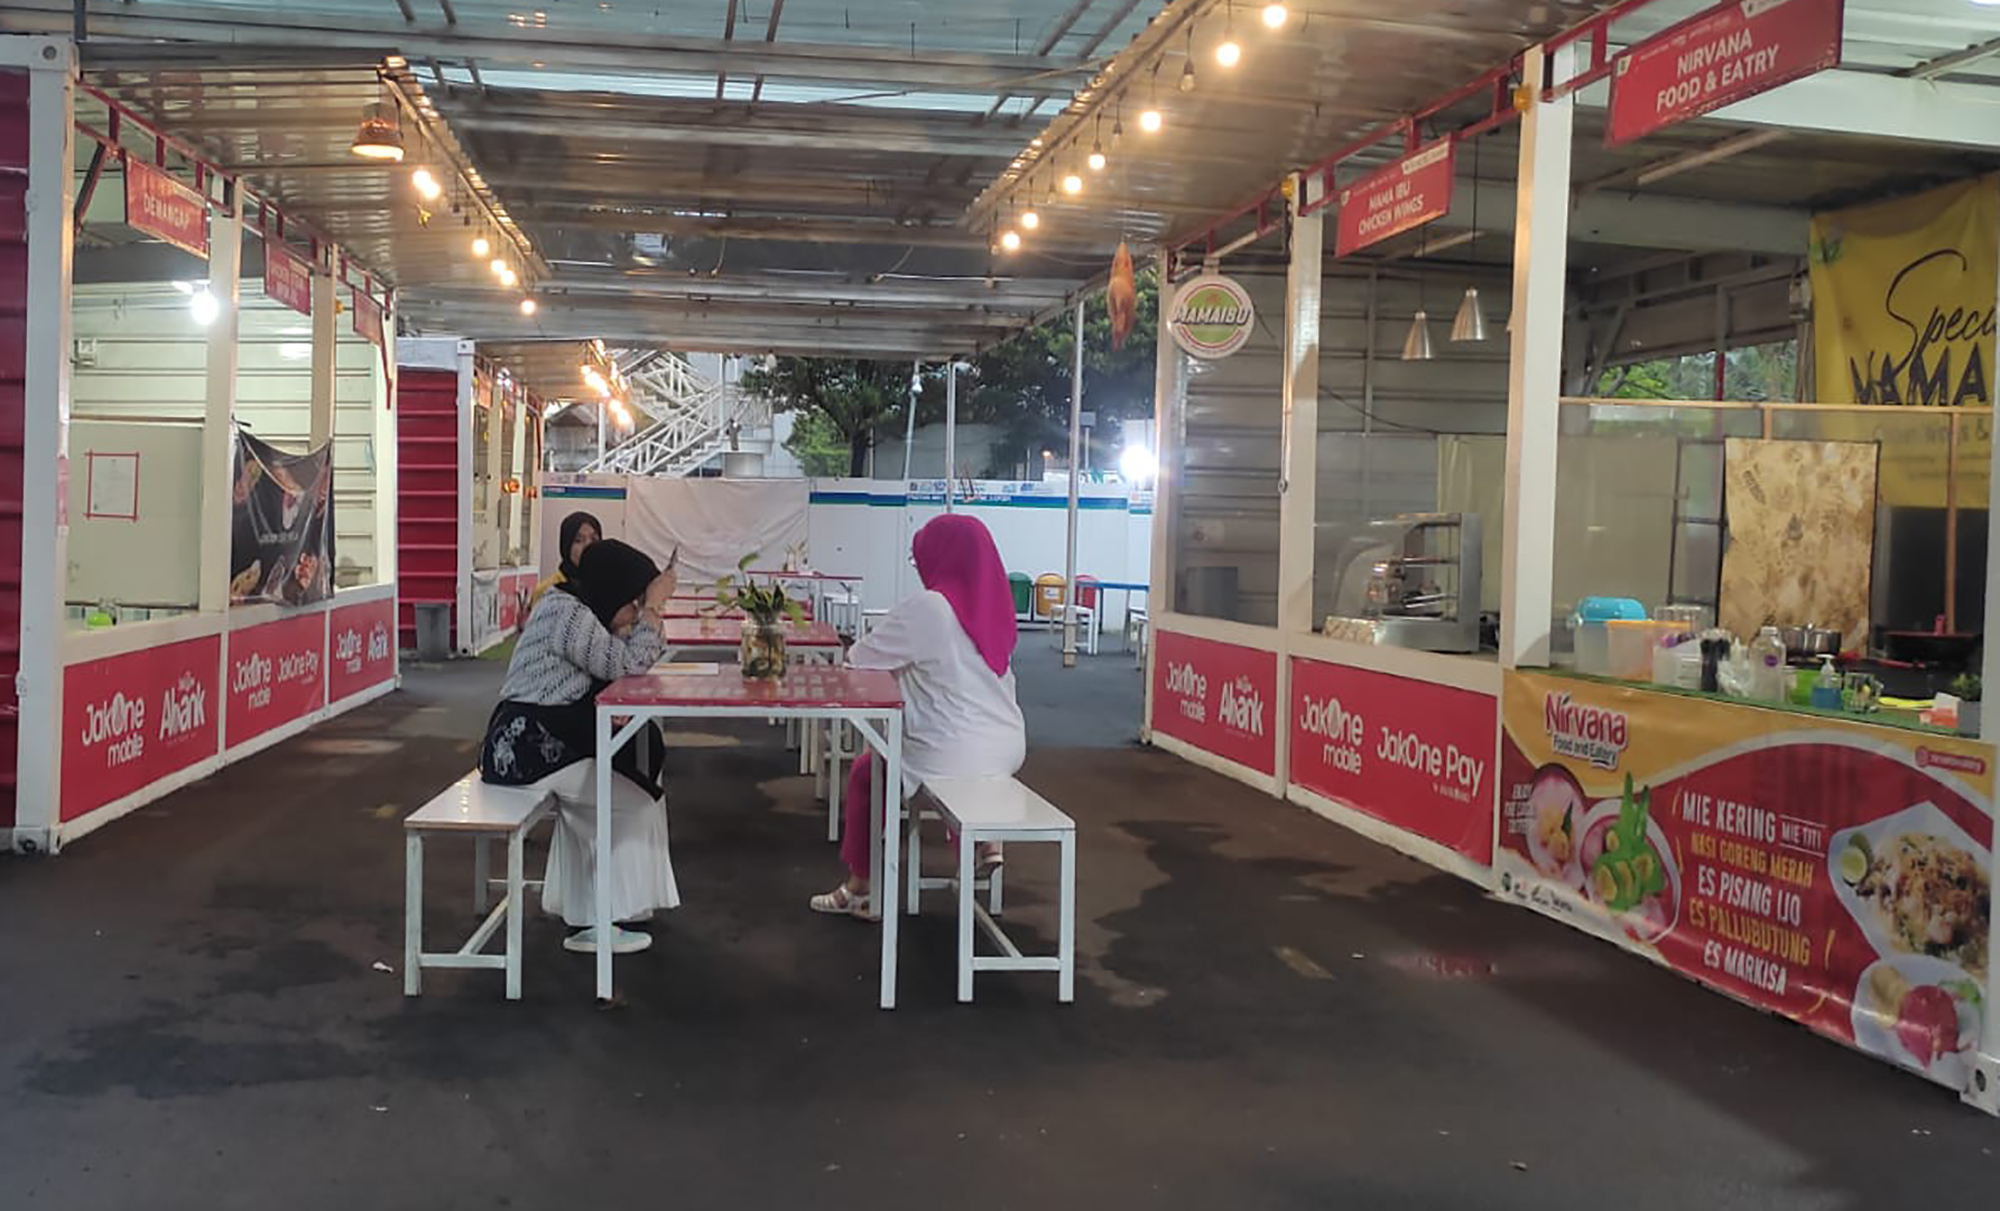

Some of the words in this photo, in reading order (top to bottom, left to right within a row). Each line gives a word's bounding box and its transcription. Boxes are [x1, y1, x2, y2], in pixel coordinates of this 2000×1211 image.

[1656, 77, 1701, 112] FOOD
[1705, 70, 1717, 93] &
[1721, 44, 1779, 87] EATRY
[1677, 28, 1752, 79] NIRVANA
[1358, 207, 1393, 235] CHICKEN
[1394, 193, 1424, 219] WINGS
[1174, 305, 1252, 327] MAMAIBU
[233, 652, 271, 693] JakOne
[277, 653, 304, 683] JakOne
[305, 650, 318, 676] Pay
[1165, 661, 1207, 700] JakOne
[82, 691, 145, 746] JakOne
[1180, 699, 1206, 724] mobile
[1300, 694, 1364, 747] JakOne
[1546, 691, 1627, 747] Nirvana
[107, 731, 144, 769] mobile
[1323, 743, 1362, 776] mobile
[1377, 726, 1443, 777] JakOne
[1446, 745, 1485, 798] Pay
[1553, 734, 1573, 752] Food
[1574, 737, 1590, 756] and
[1682, 791, 1712, 827] MIE
[1716, 798, 1777, 844] KERING
[1781, 821, 1800, 844] MIE
[1802, 826, 1822, 850] TITI
[1691, 832, 1716, 860] NASI
[1719, 838, 1769, 874] GORENG
[1769, 852, 1815, 889] MERAH
[1698, 865, 1716, 897] ES
[1719, 871, 1773, 917] PISANG
[1777, 888, 1802, 928] IJO
[1689, 897, 1706, 929] ES
[1708, 904, 1812, 968] PALLUBUTUNG
[1704, 939, 1723, 969] ES
[1724, 946, 1788, 996] MARKISA
